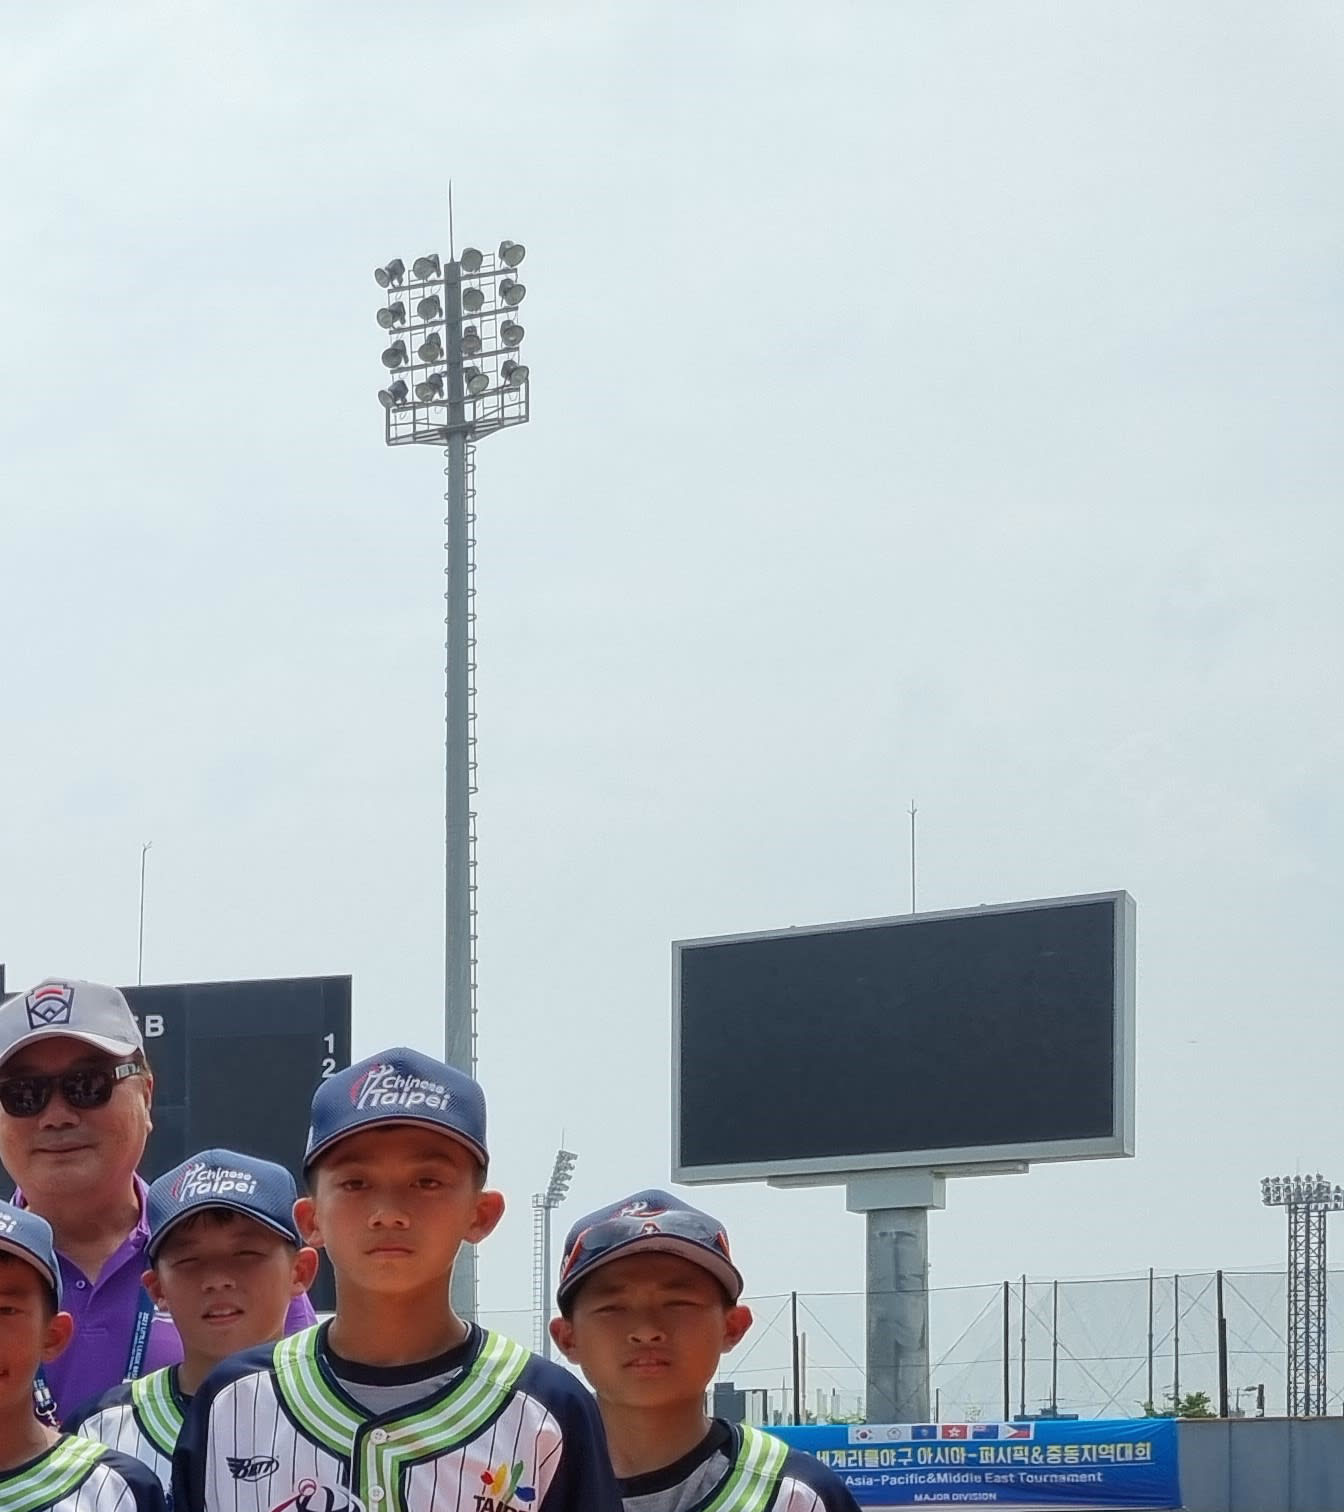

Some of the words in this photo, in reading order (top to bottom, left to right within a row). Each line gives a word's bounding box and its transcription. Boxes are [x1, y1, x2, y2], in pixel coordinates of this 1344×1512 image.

[324, 1033, 335, 1053] 1
[322, 1058, 336, 1078] 2
[382, 1074, 444, 1094] Chinese
[370, 1088, 451, 1111] Taipei
[197, 1167, 252, 1181] Chinese
[188, 1180, 257, 1197] Taipei
[845, 1472, 981, 1486] Asia-Pacific&Middle
[985, 1472, 1015, 1483] East
[1019, 1472, 1103, 1483] Tournament
[914, 1493, 949, 1501] MAJOR
[952, 1493, 997, 1501] DIVISION
